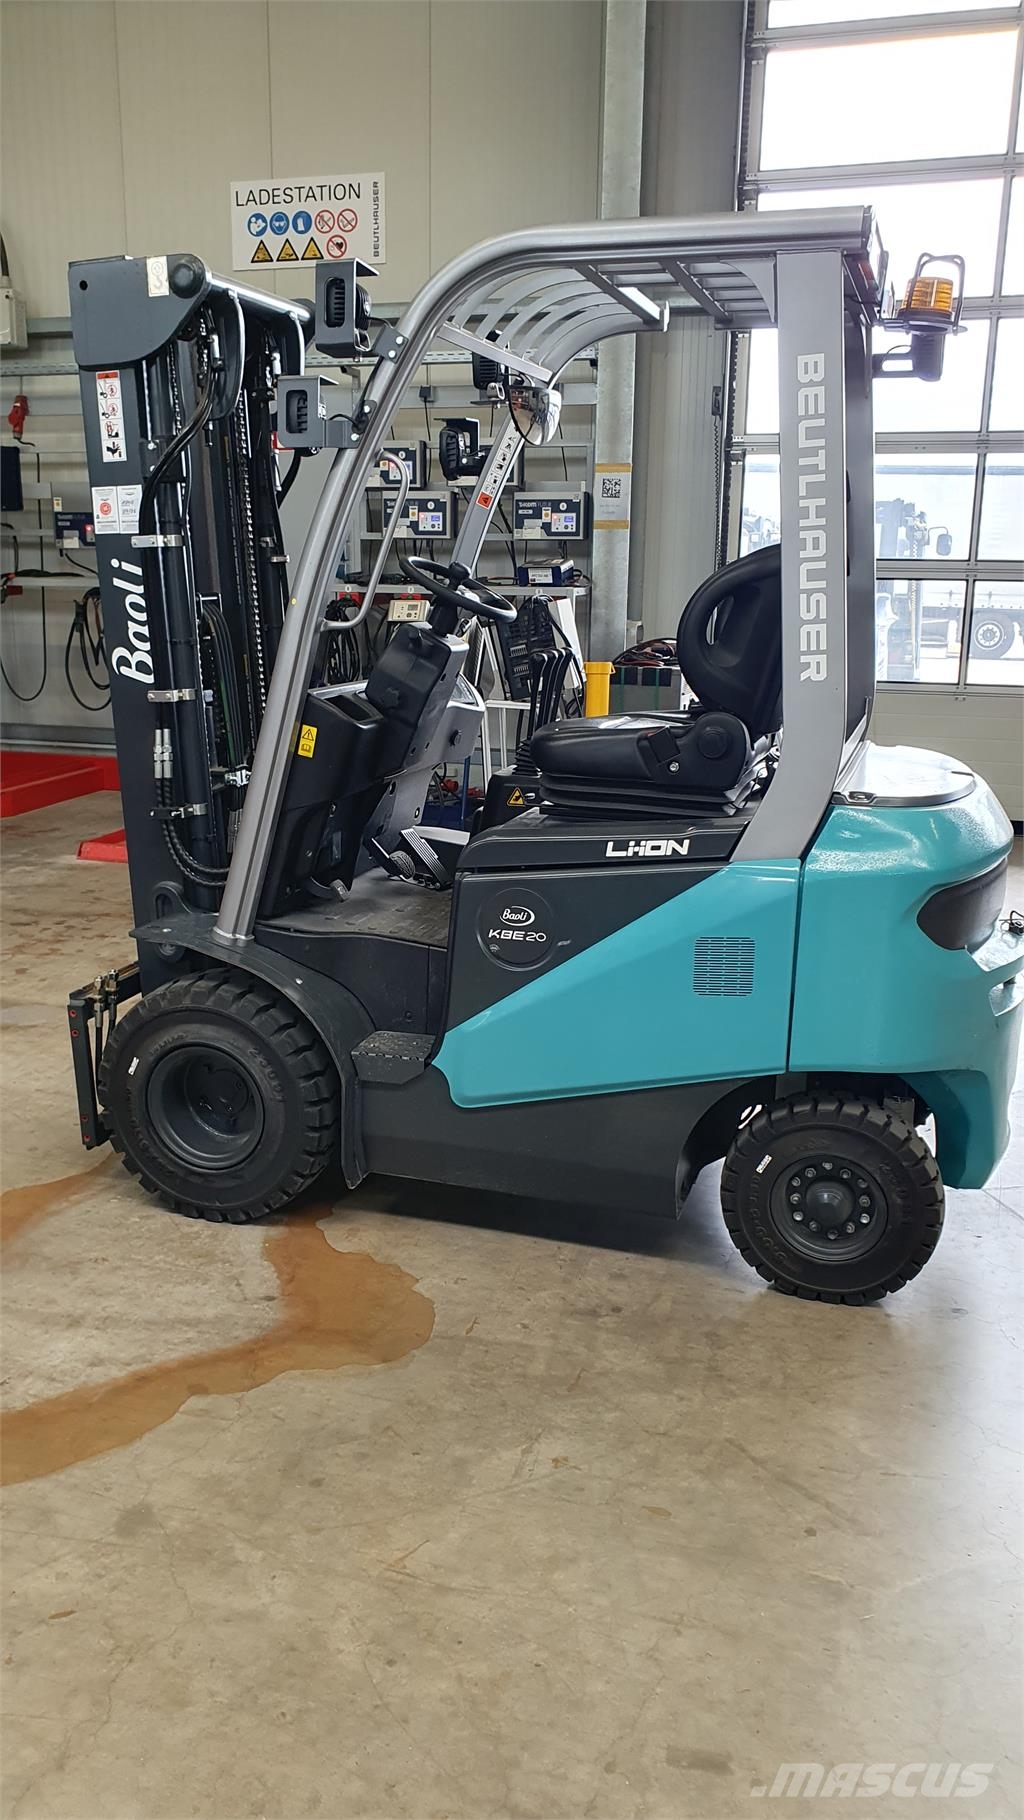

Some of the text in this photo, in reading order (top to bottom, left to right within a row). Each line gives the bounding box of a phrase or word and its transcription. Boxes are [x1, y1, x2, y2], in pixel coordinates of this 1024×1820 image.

[235, 182, 361, 207] LADESTATION
[372, 181, 380, 258] BEUTLHAUSER
[797, 352, 828, 683] BEUTLHAUSER
[110, 558, 155, 684] Baoli
[488, 928, 547, 942] KBE20
[502, 908, 528, 921] Baoli
